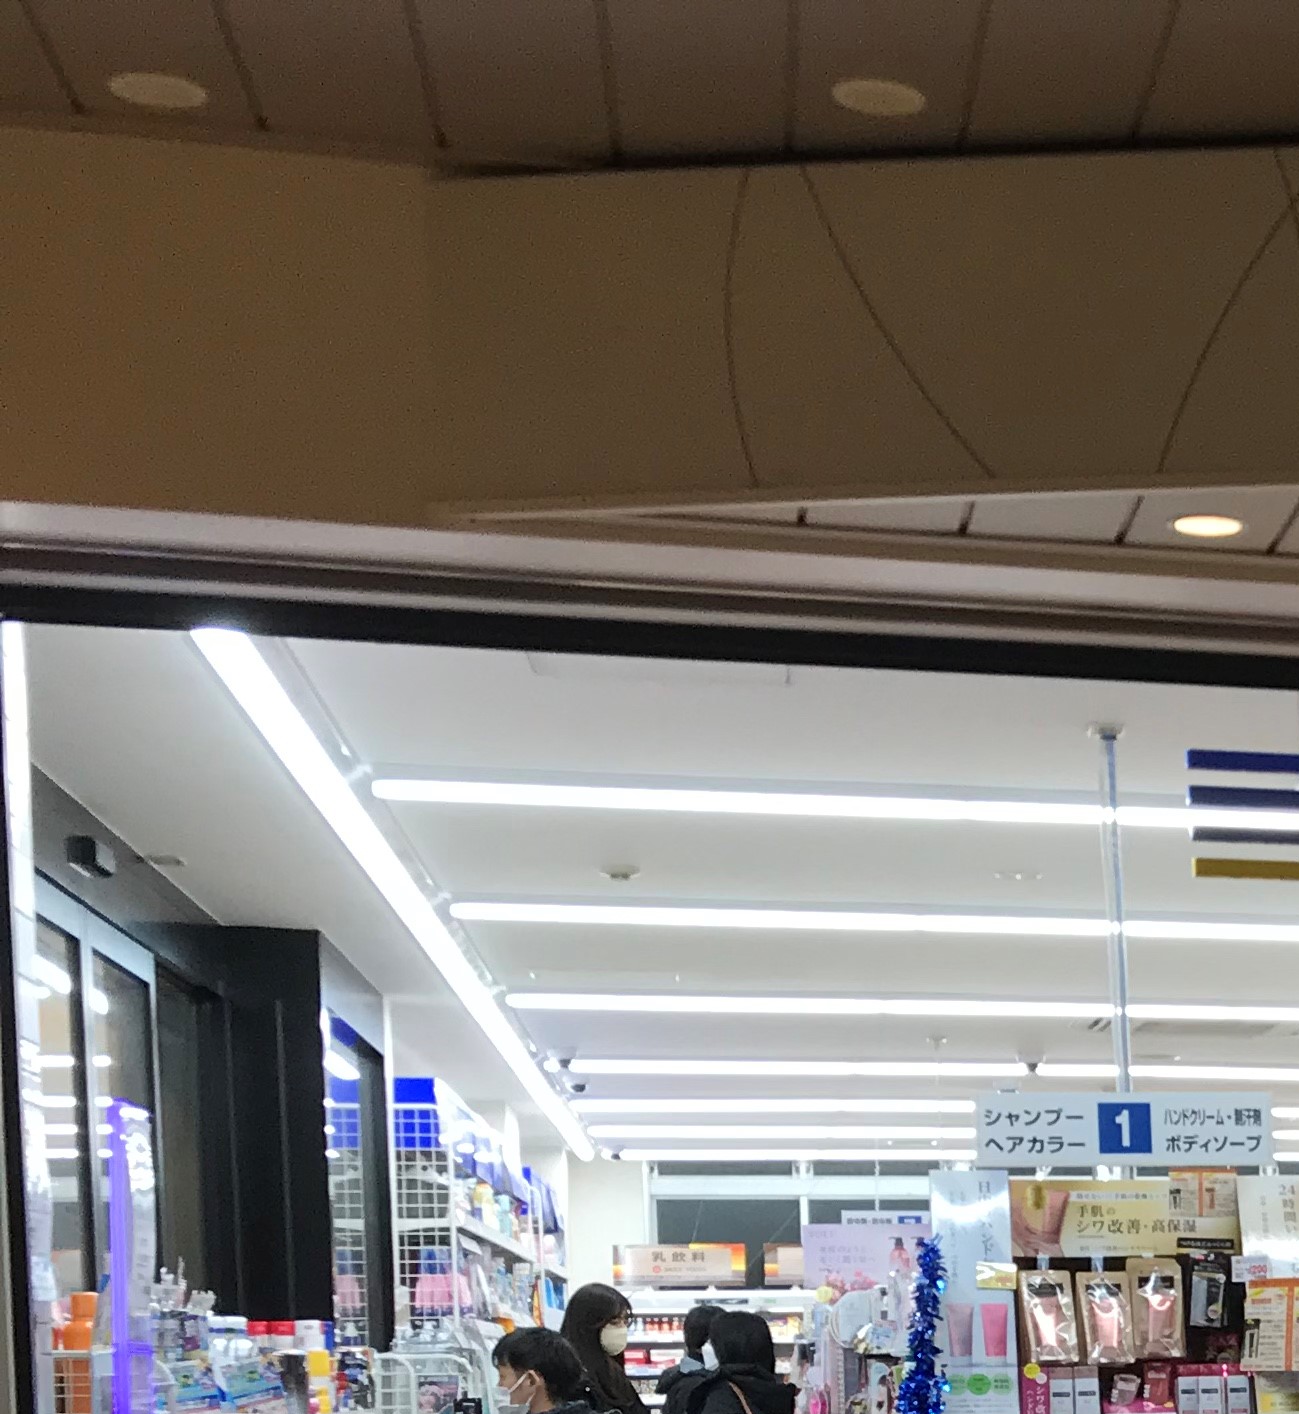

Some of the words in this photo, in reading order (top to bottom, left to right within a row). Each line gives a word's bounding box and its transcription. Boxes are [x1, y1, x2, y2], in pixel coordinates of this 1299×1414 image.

[984, 1107, 1084, 1126] シャンプー
[1115, 1109, 1131, 1148] 1
[985, 1135, 1086, 1153] ヘアカラー
[1165, 1135, 1262, 1153] ボディソープ
[652, 1251, 705, 1263] 乳飲料
